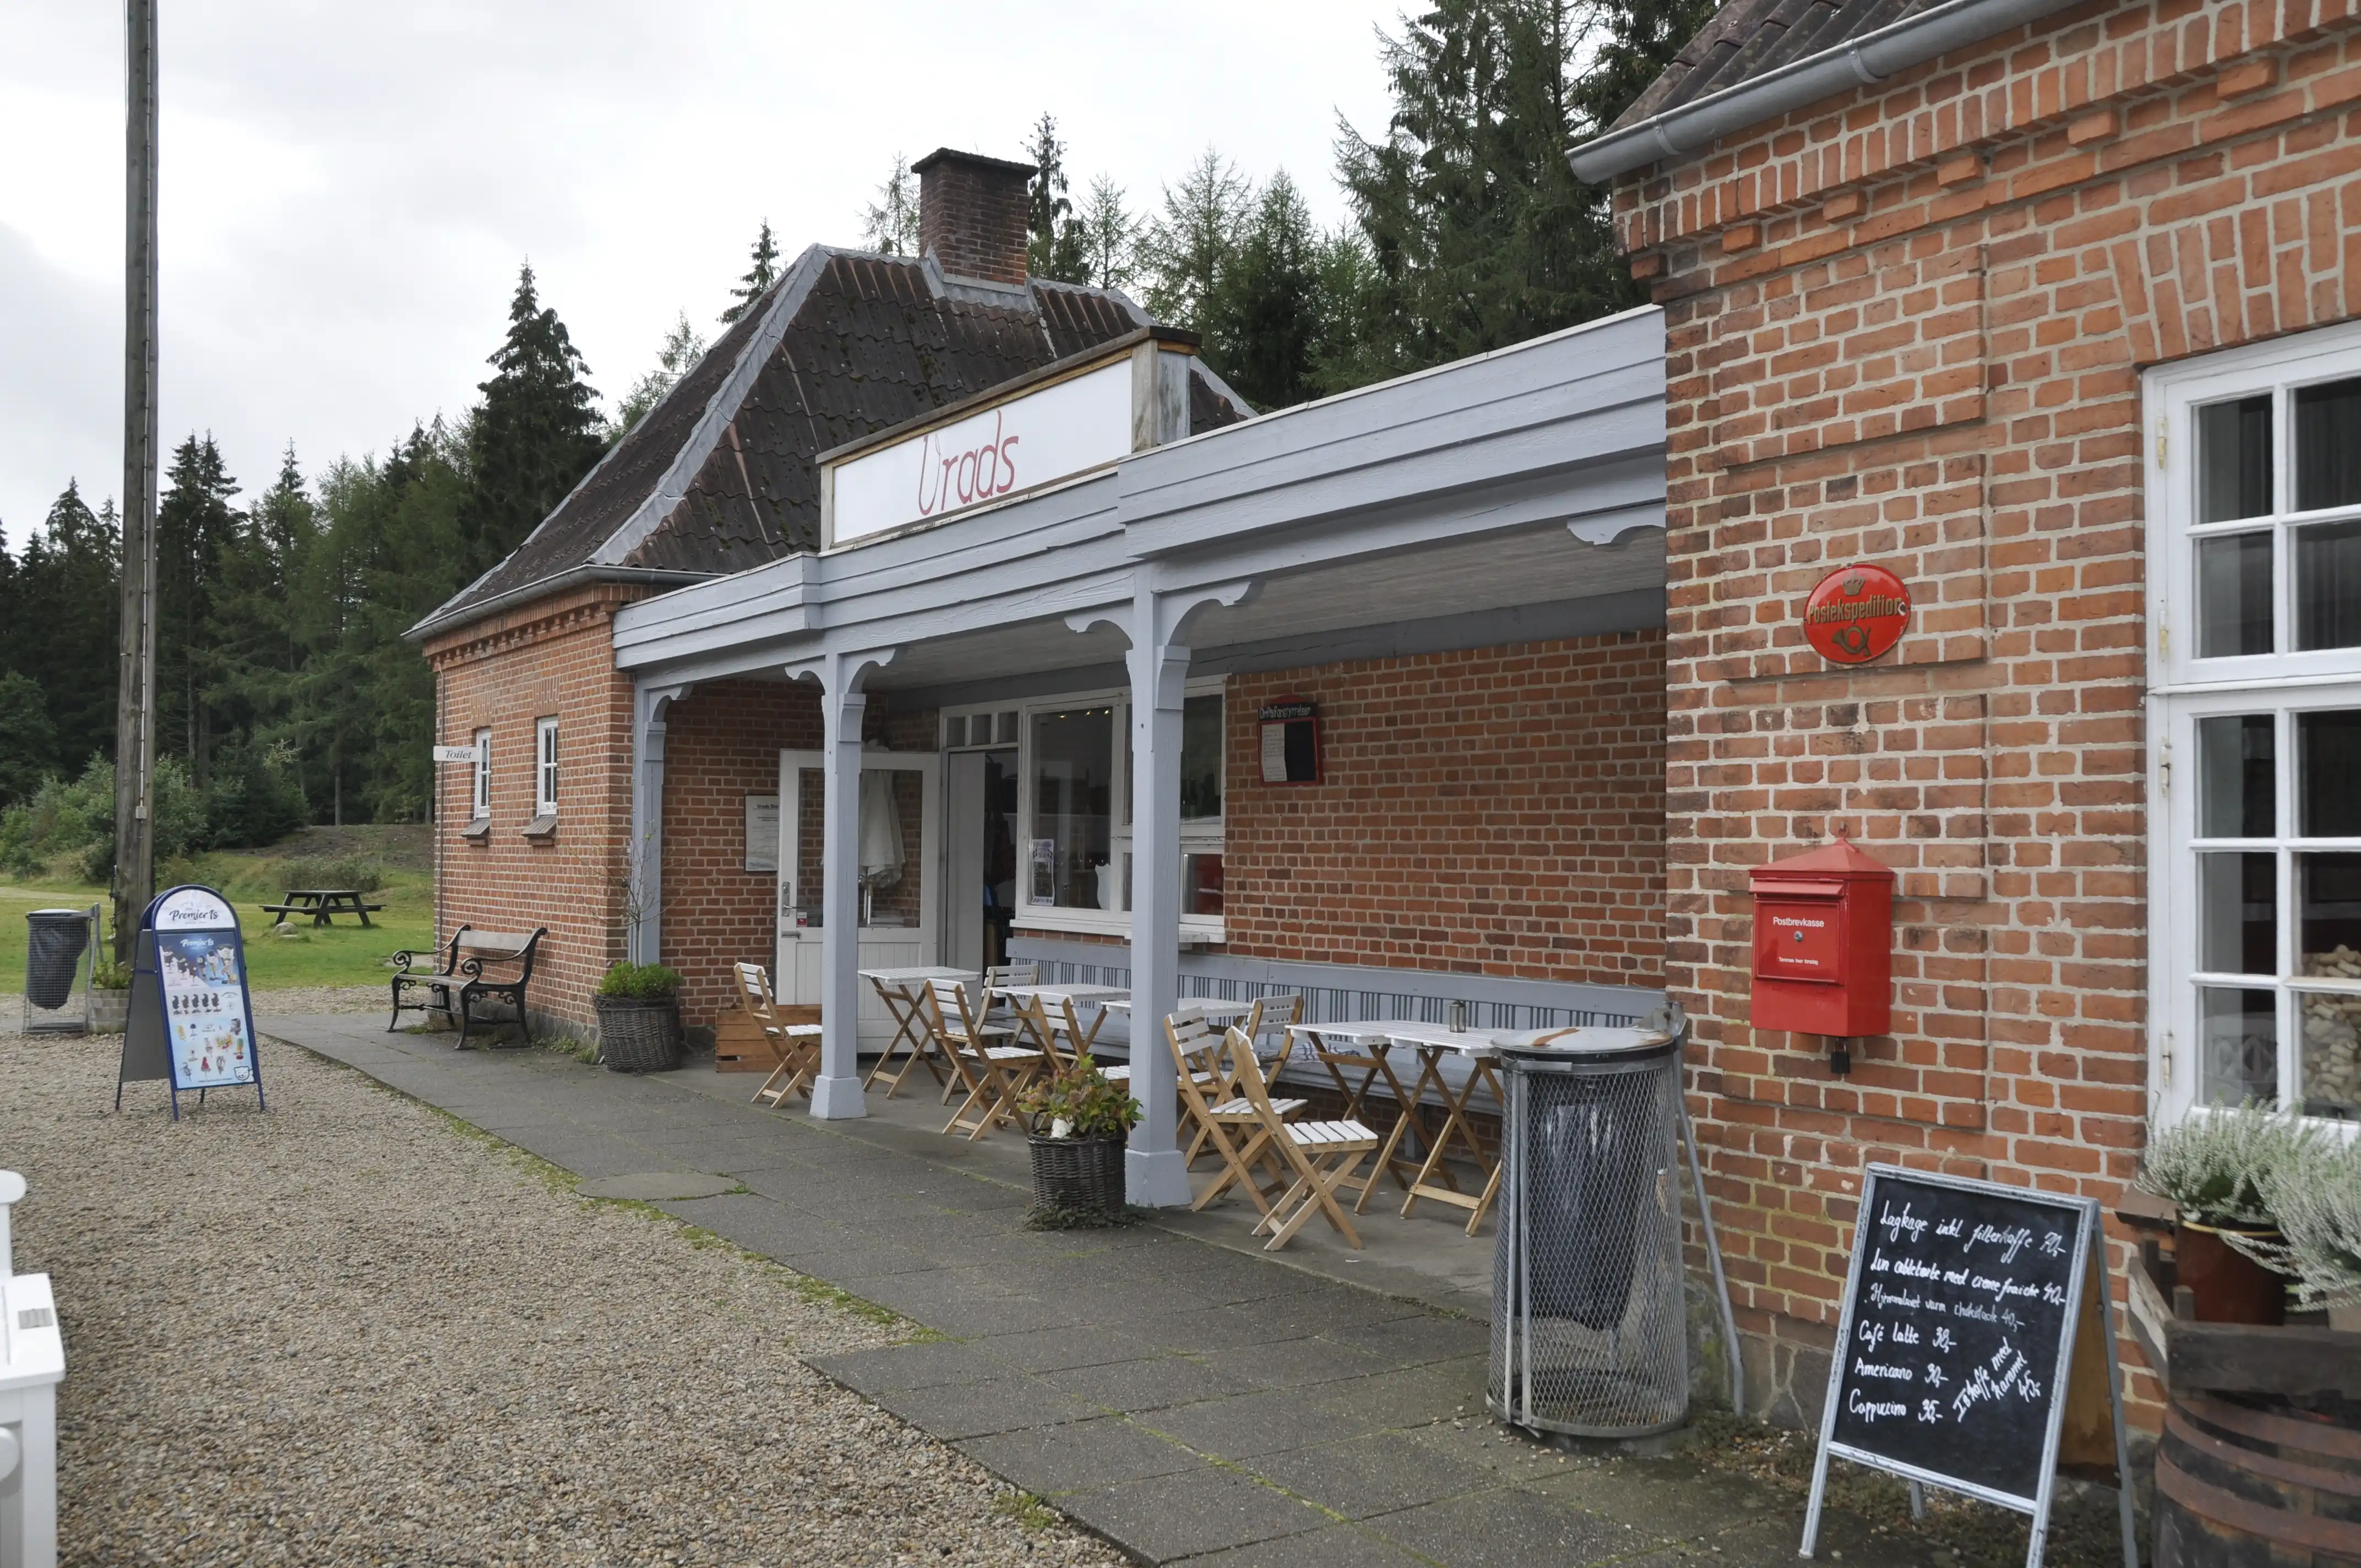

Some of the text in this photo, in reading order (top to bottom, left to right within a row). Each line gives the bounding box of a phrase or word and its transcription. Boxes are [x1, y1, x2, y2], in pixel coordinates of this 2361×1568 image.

[1808, 595, 1902, 625] Postekspedition
[445, 749, 472, 759] Toilet
[169, 910, 208, 921] Premier
[1773, 916, 1825, 928] Postbrevkasse
[180, 938, 208, 948] Premier
[1880, 1199, 1928, 1243] Lagkage
[1963, 1223, 2033, 1264] filterkaffe
[1870, 1247, 1890, 1271] Lun
[1943, 1268, 1970, 1286] med
[1925, 1299, 1947, 1313] varm
[1892, 1321, 1919, 1344] latte
[1854, 1357, 1913, 1381] Americano
[1952, 1336, 2012, 1423] Iskaffe med
[1991, 1349, 2028, 1401] karamel
[1849, 1388, 1907, 1423] Cappuccino
